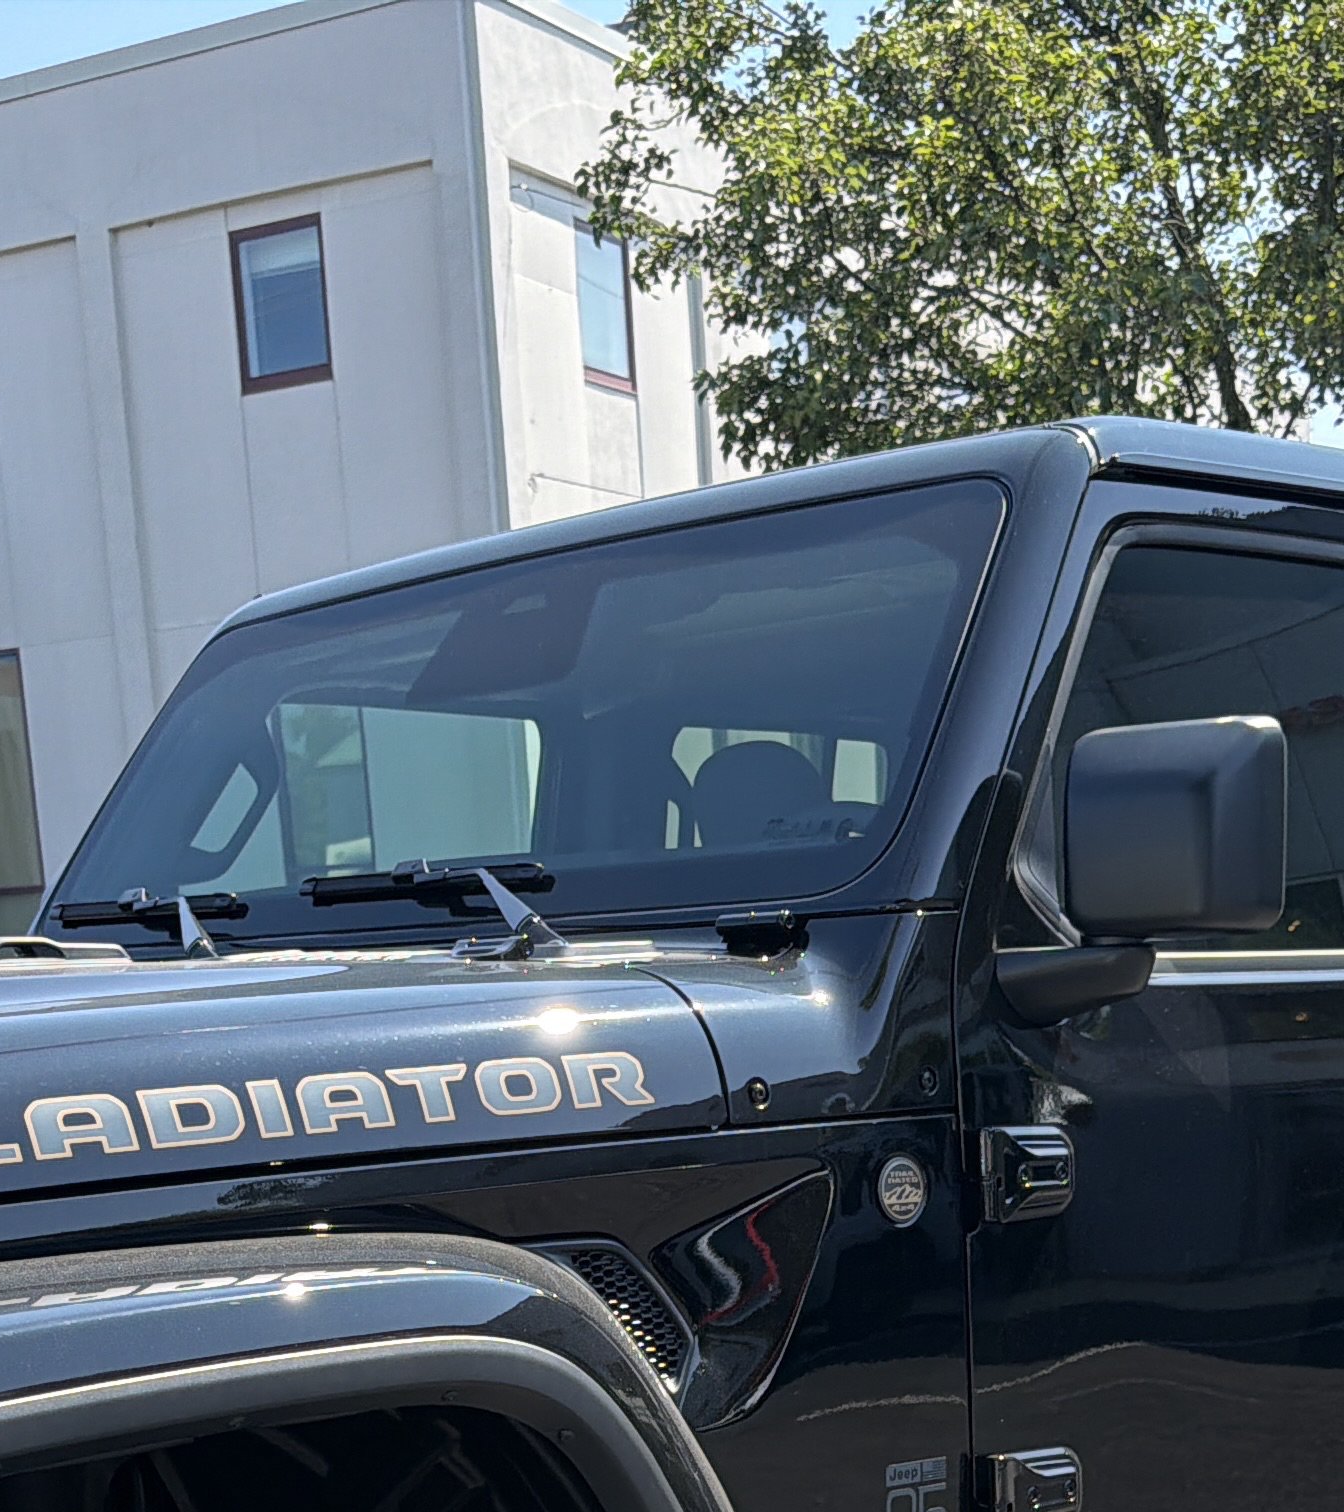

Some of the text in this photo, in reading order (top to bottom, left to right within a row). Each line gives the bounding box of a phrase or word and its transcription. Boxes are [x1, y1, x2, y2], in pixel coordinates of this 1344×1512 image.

[889, 1170, 914, 1178] TRAIL
[887, 1176, 918, 1184] RATED
[888, 1466, 919, 1482] Jeep
